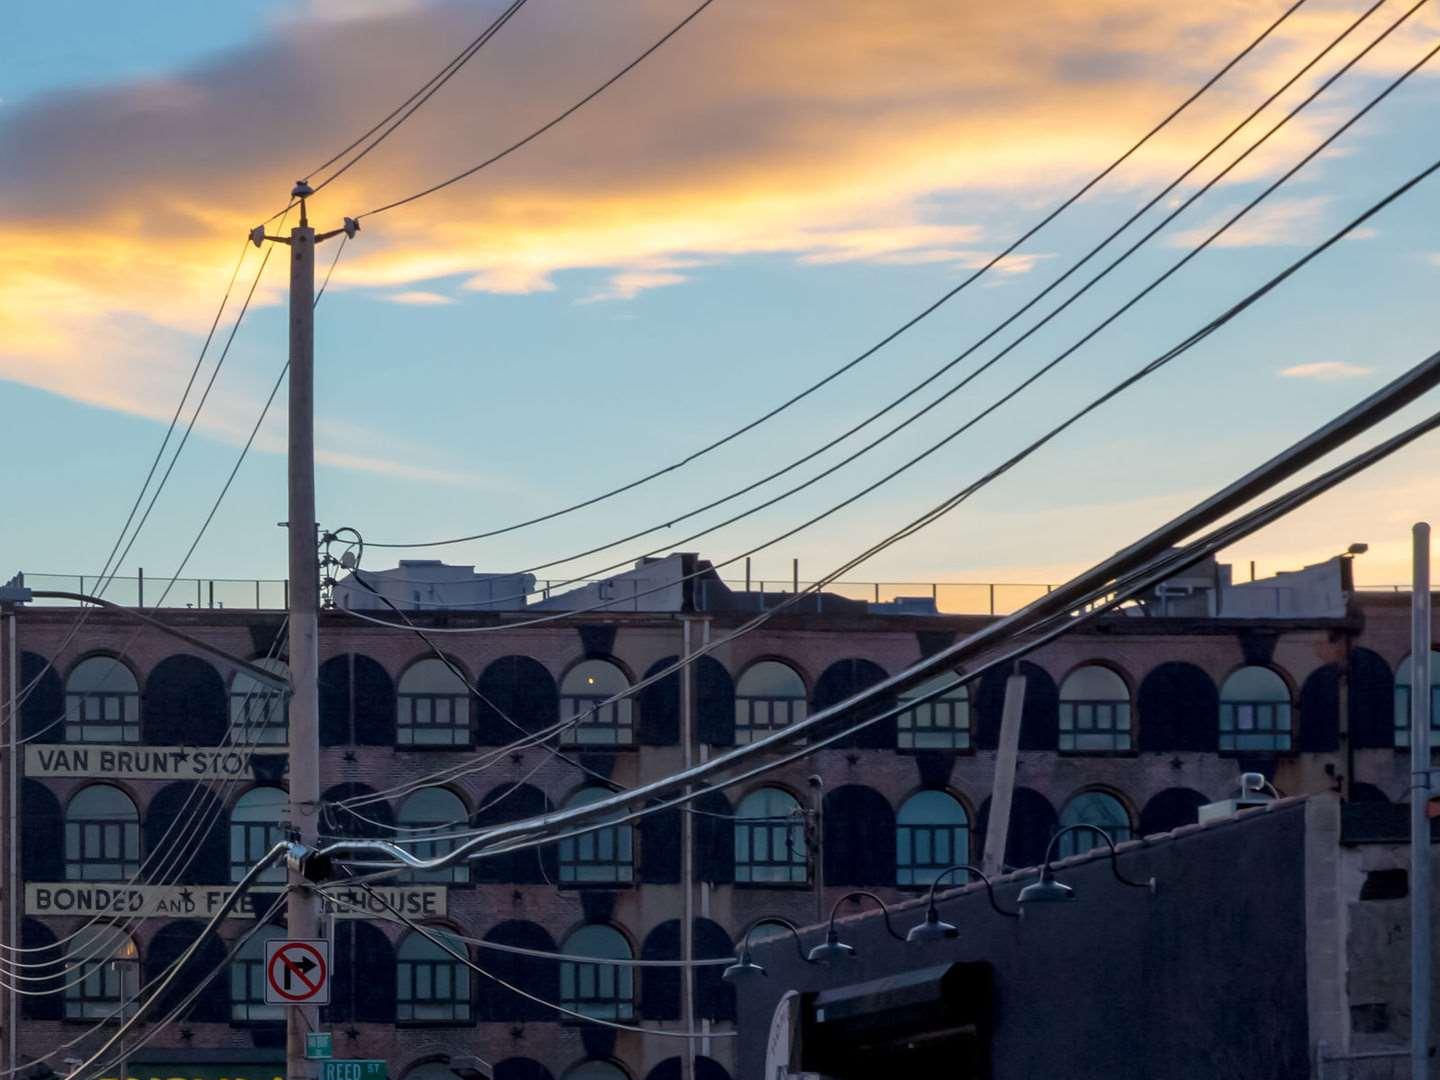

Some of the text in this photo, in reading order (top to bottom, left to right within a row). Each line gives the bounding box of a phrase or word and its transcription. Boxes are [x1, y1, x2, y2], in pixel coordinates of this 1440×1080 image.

[38, 750, 88, 772] VAN
[100, 751, 180, 773] BRUNT
[36, 889, 144, 912] BONDED
[157, 898, 195, 913] AND
[326, 1063, 380, 1080] REED ST
